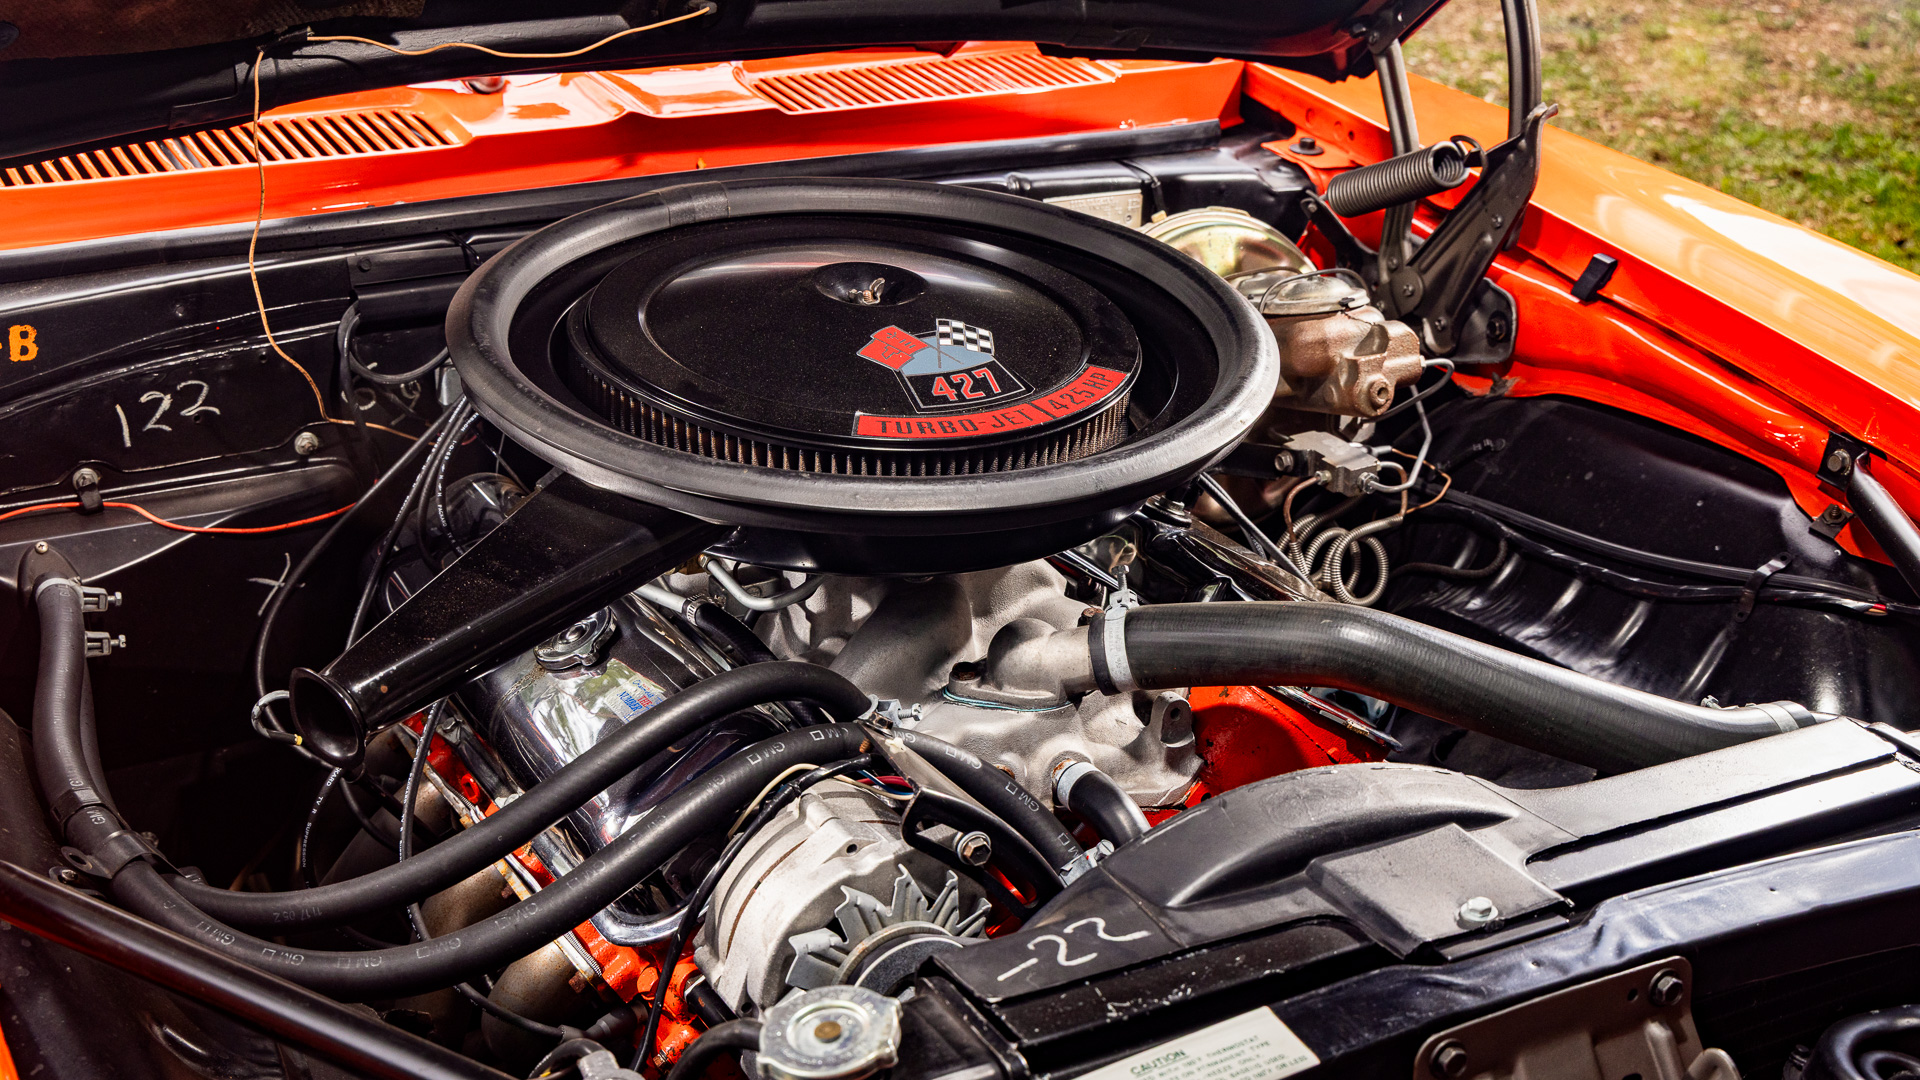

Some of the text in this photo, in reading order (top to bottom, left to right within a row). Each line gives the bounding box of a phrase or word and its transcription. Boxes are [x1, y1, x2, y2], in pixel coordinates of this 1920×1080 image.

[932, 367, 1002, 401] 427
[115, 380, 221, 448] 122
[876, 371, 1116, 436] TURBO-JET 425 HP
[764, 741, 786, 758] GM
[956, 752, 983, 770] GM
[326, 767, 342, 787] KARD
[1018, 791, 1040, 812] GM
[1206, 1034, 1260, 1059] THERMOSTAT
[1130, 1049, 1187, 1076] CAUTION
